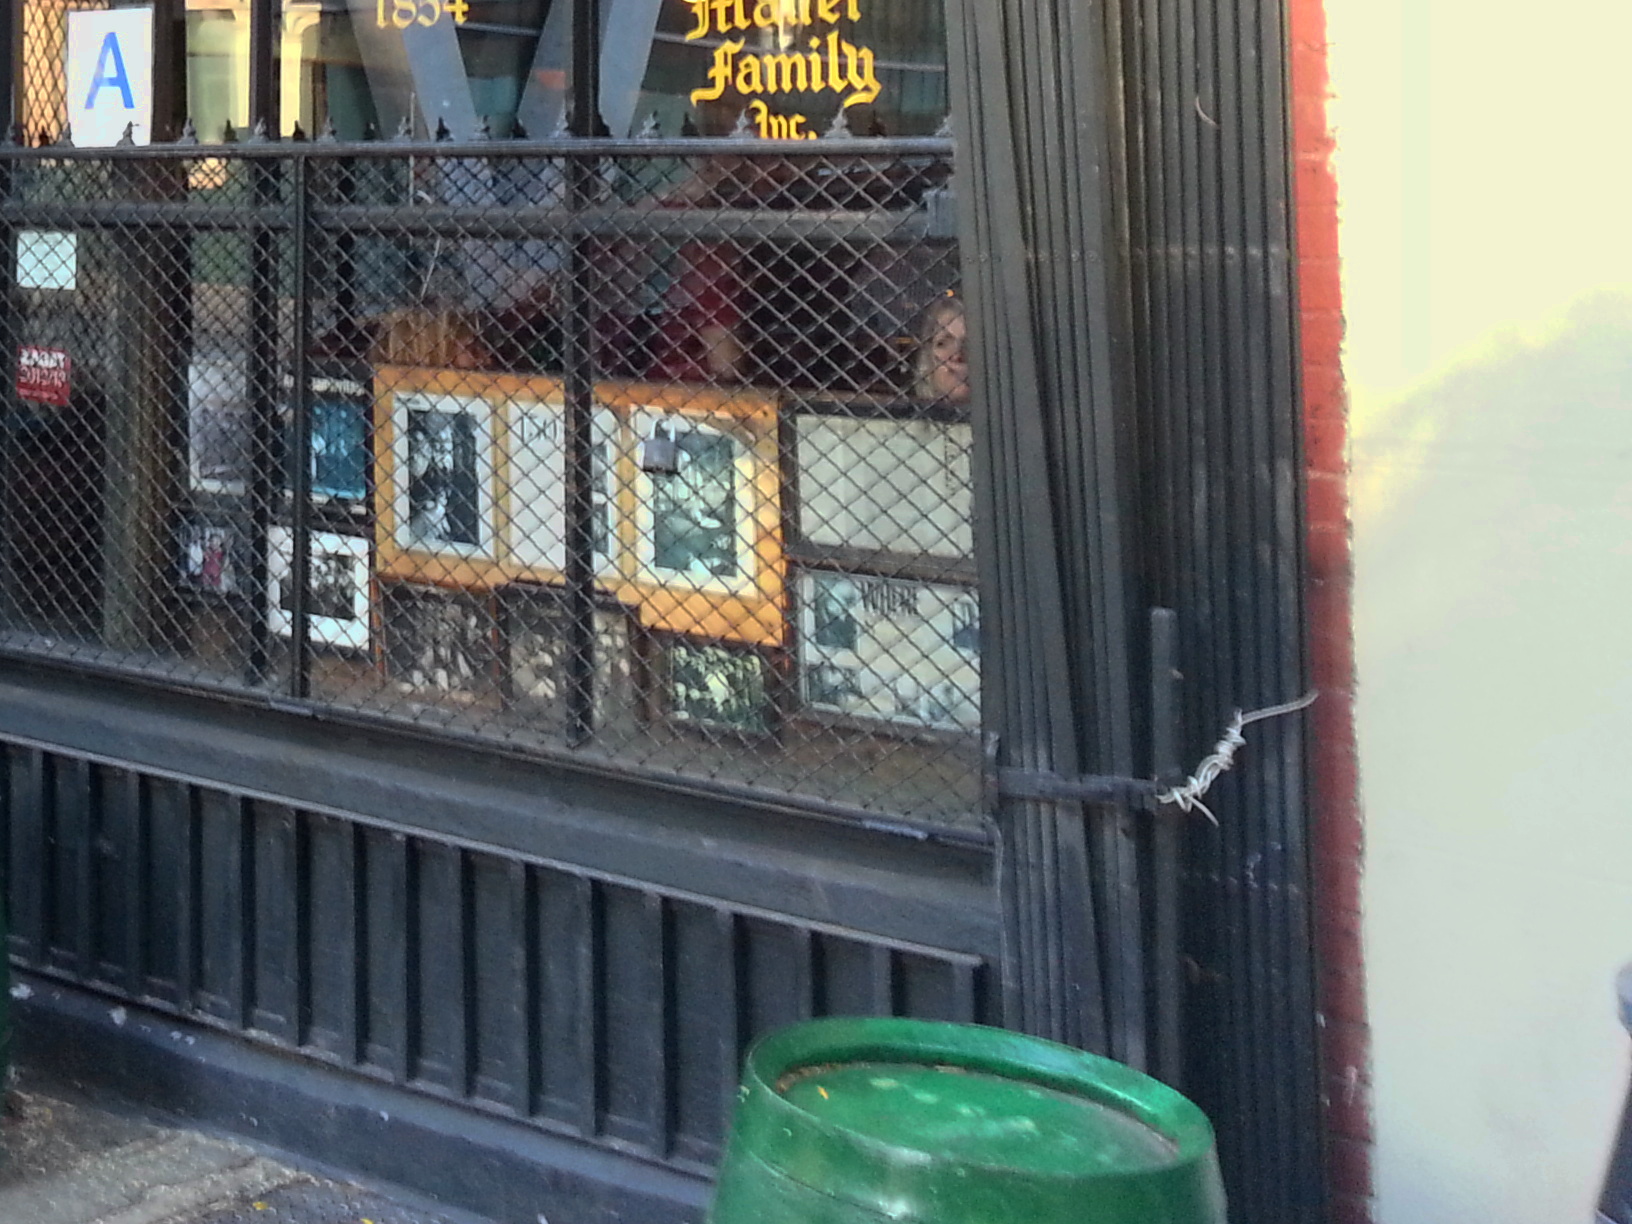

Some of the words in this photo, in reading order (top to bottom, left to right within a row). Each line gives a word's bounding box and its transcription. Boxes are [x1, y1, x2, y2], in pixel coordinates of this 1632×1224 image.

[84, 31, 135, 110] A
[690, 30, 883, 108] Family
[748, 99, 818, 140] Inc.
